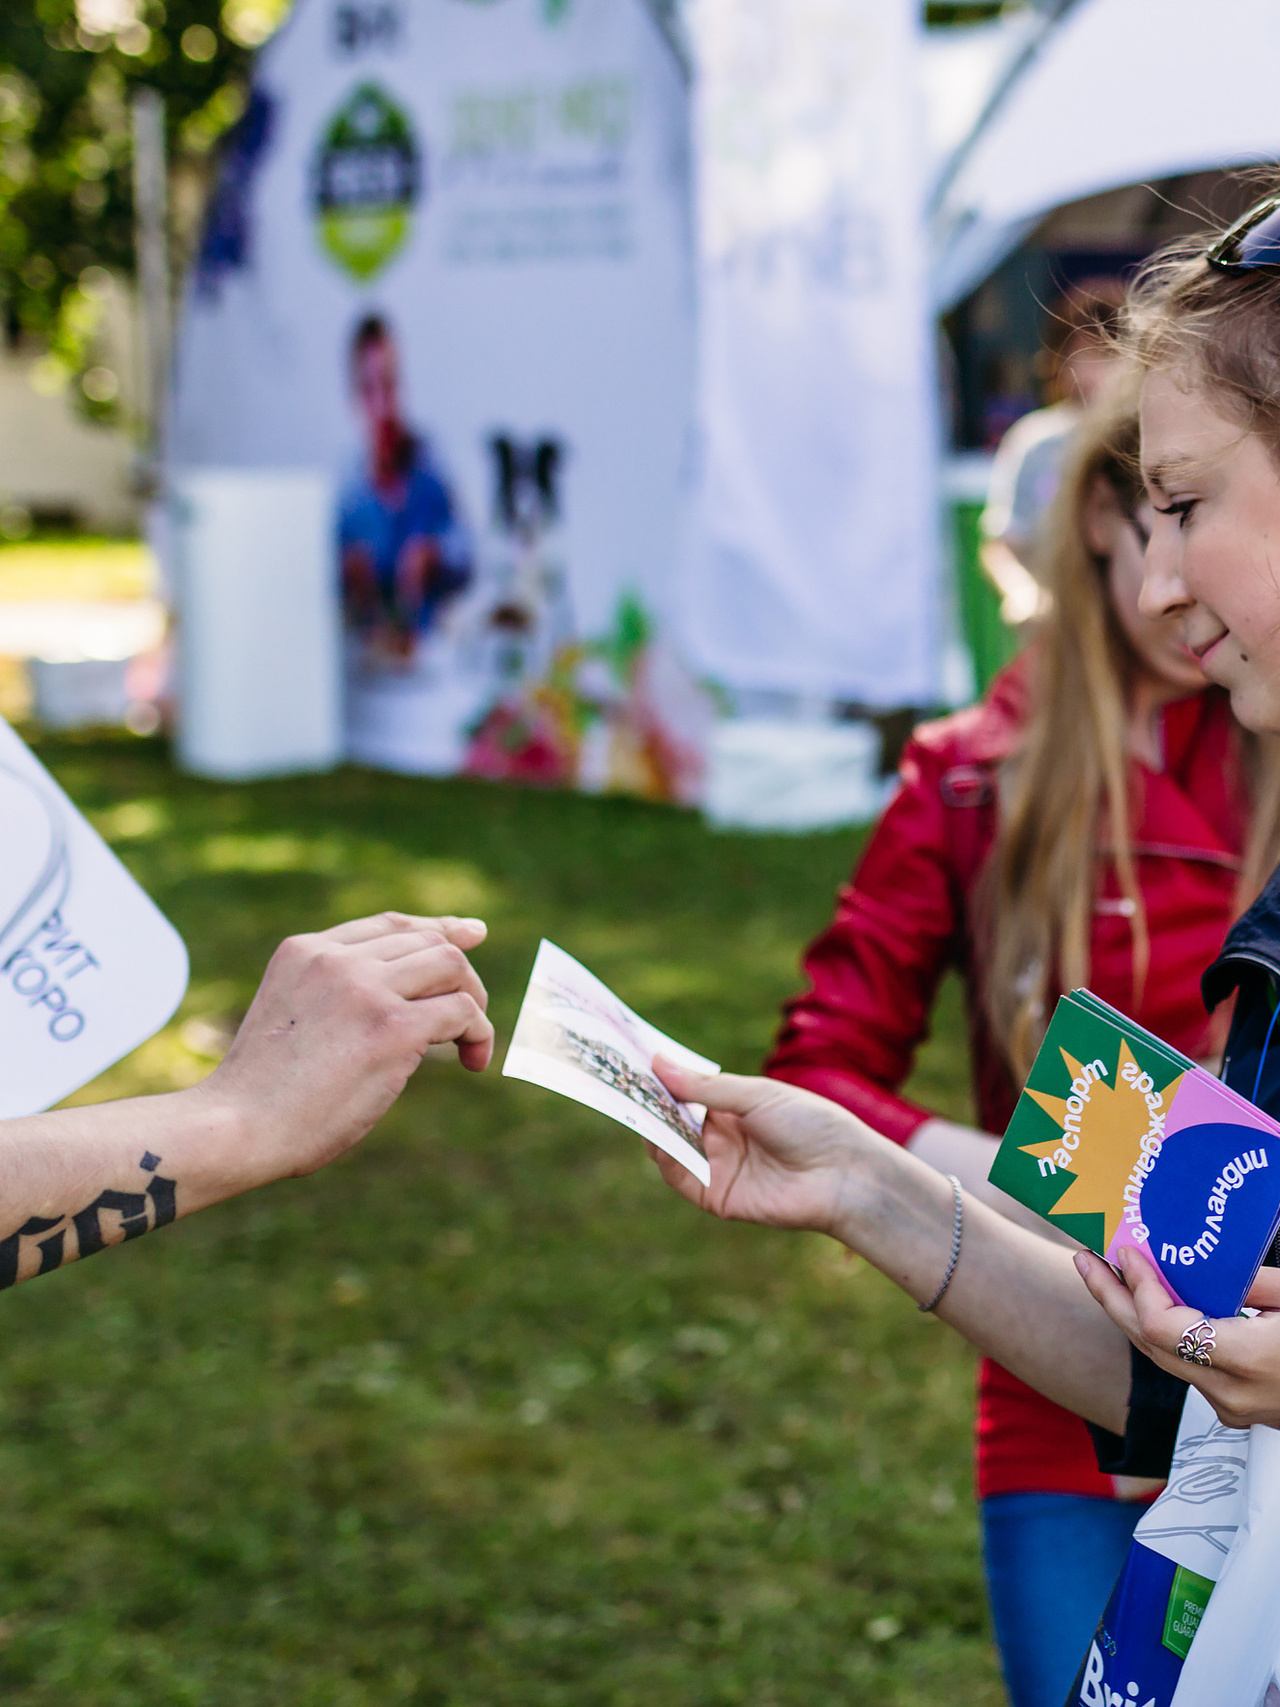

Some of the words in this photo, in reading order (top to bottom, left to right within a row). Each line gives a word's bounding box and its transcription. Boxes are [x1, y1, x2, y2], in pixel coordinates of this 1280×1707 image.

[1037, 1058, 1109, 1178] паспорт
[1121, 1061, 1167, 1245] гражданина
[1160, 1148, 1269, 1266] петландии
